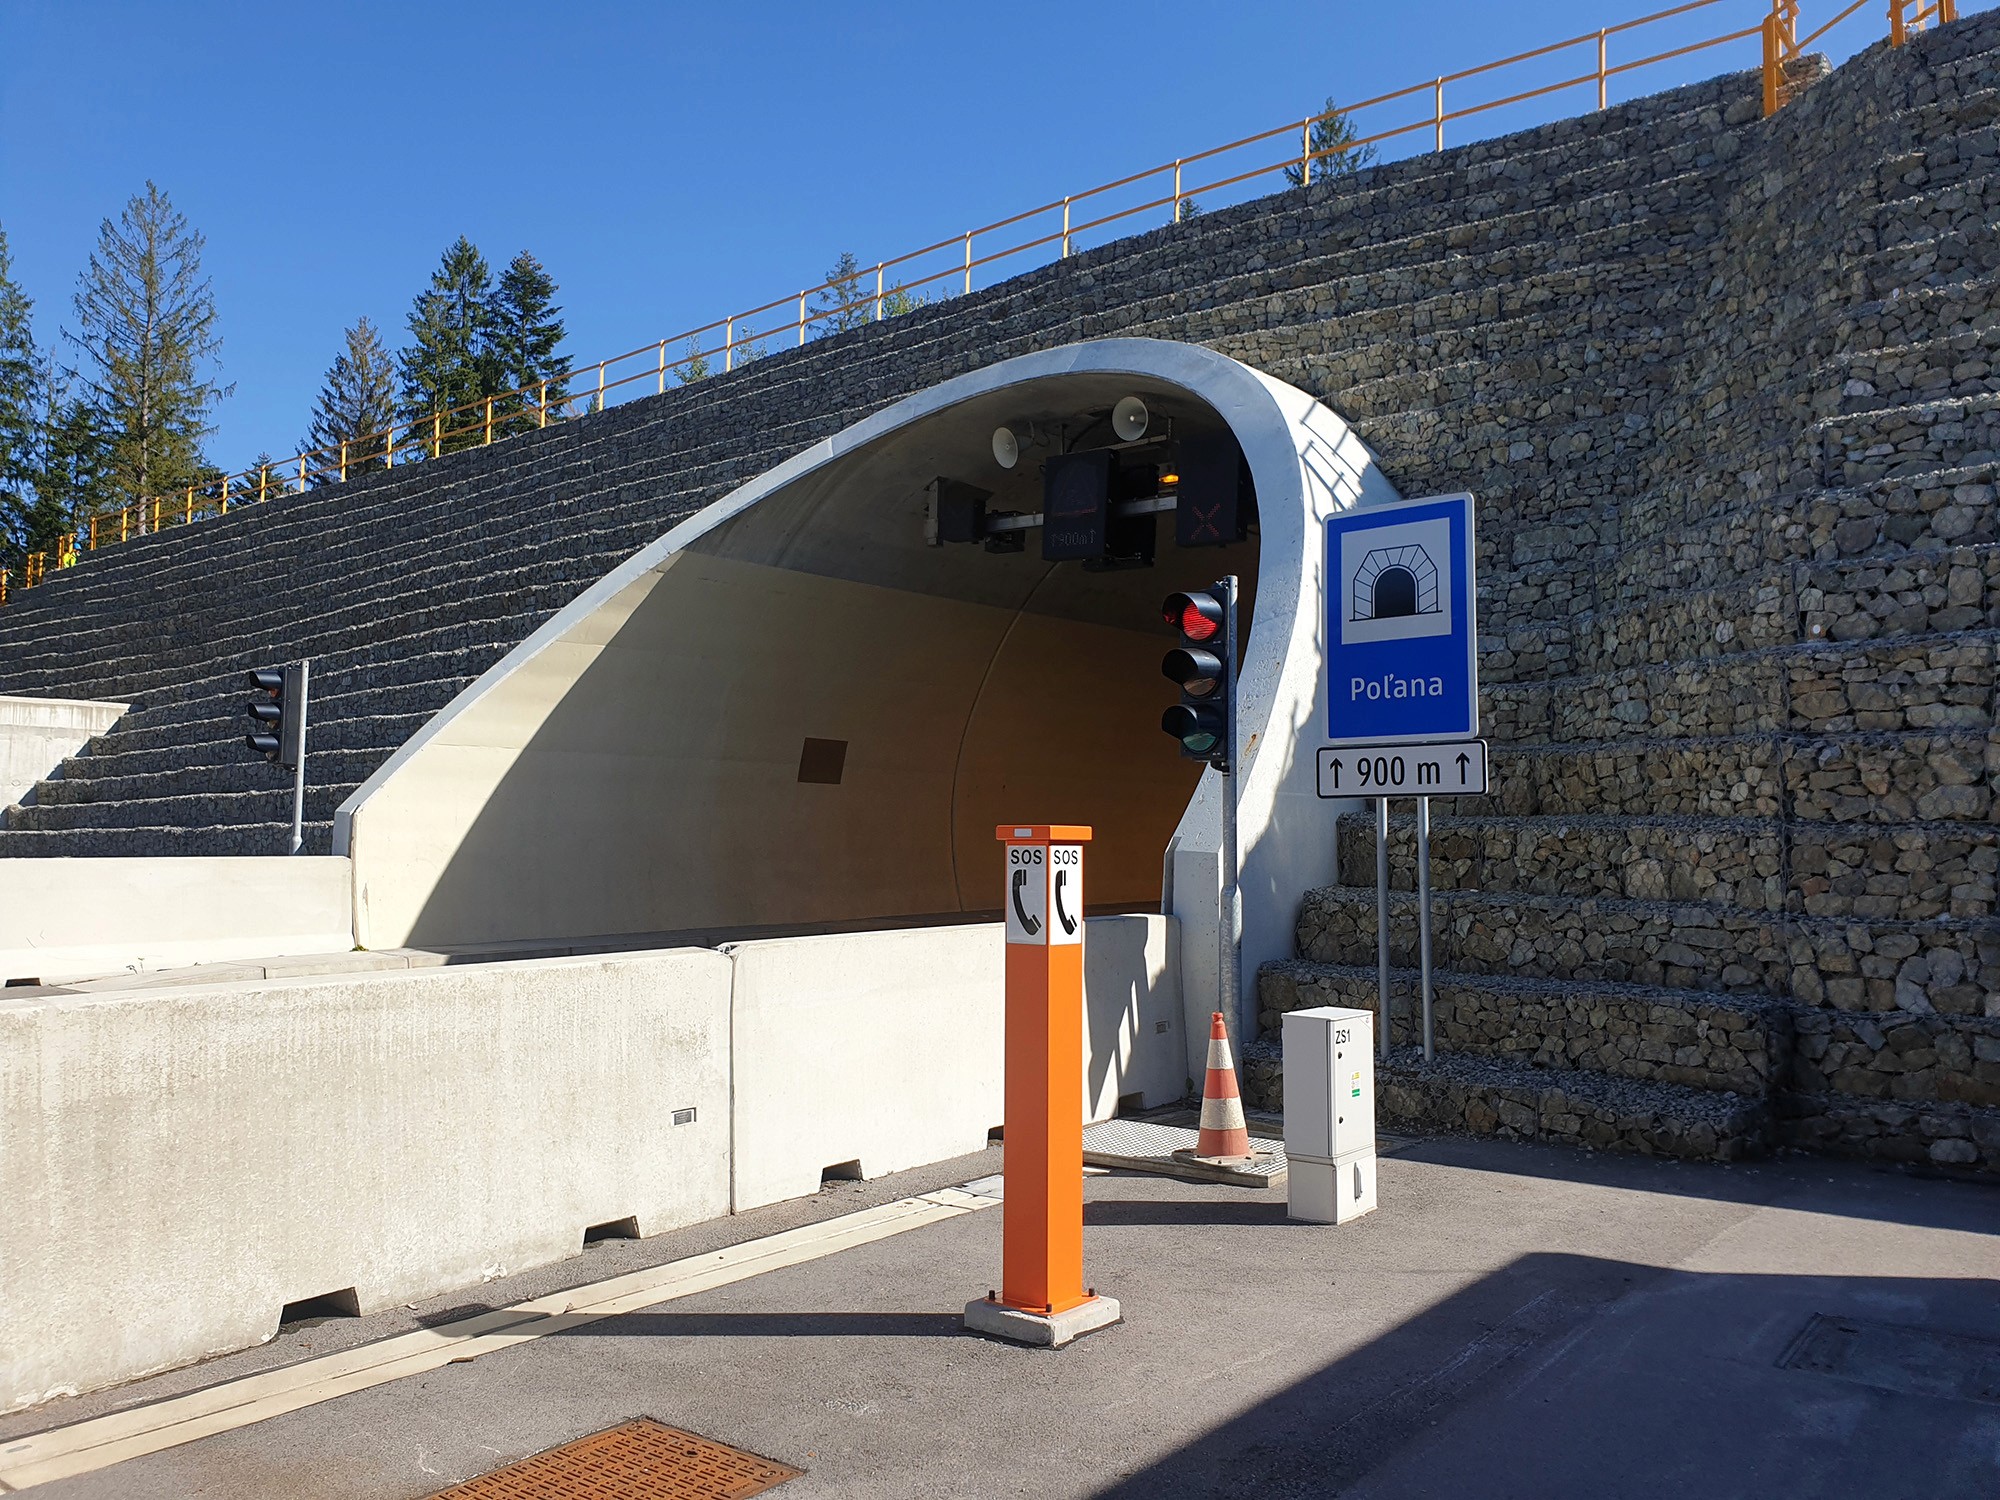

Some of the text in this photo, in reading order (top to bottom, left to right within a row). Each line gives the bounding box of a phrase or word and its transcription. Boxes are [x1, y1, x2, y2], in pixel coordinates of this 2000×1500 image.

[1350, 673, 1443, 701] Poľana
[1357, 756, 1441, 787] 900 m
[1010, 849, 1042, 865] SOS
[1053, 849, 1078, 865] SOS
[1335, 1028, 1351, 1045] ZS1
